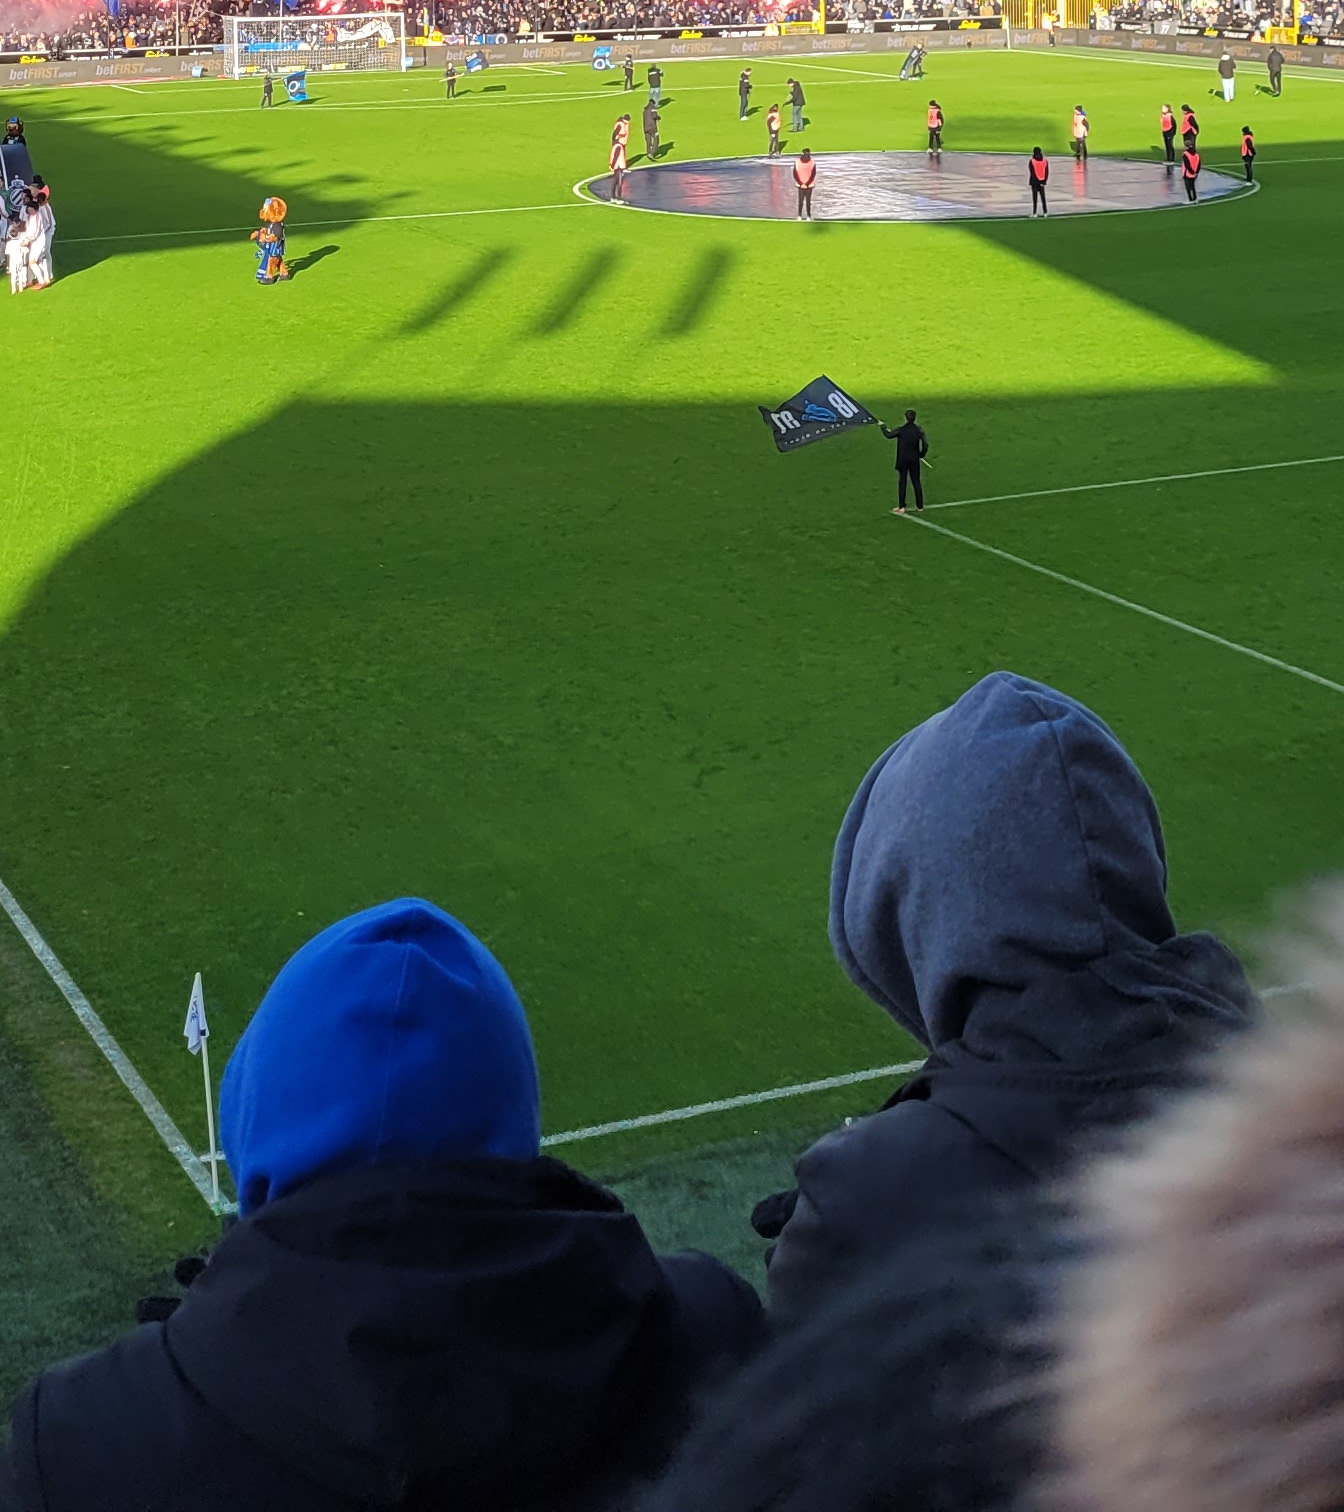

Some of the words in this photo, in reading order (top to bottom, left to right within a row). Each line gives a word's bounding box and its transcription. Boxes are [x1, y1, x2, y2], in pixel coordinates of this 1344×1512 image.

[671, 42, 713, 54] betFIRST
[742, 40, 783, 52] betFIRST
[523, 47, 567, 59] betFIRST
[9, 66, 61, 80] betFIRST
[96, 62, 146, 76] betFIRST
